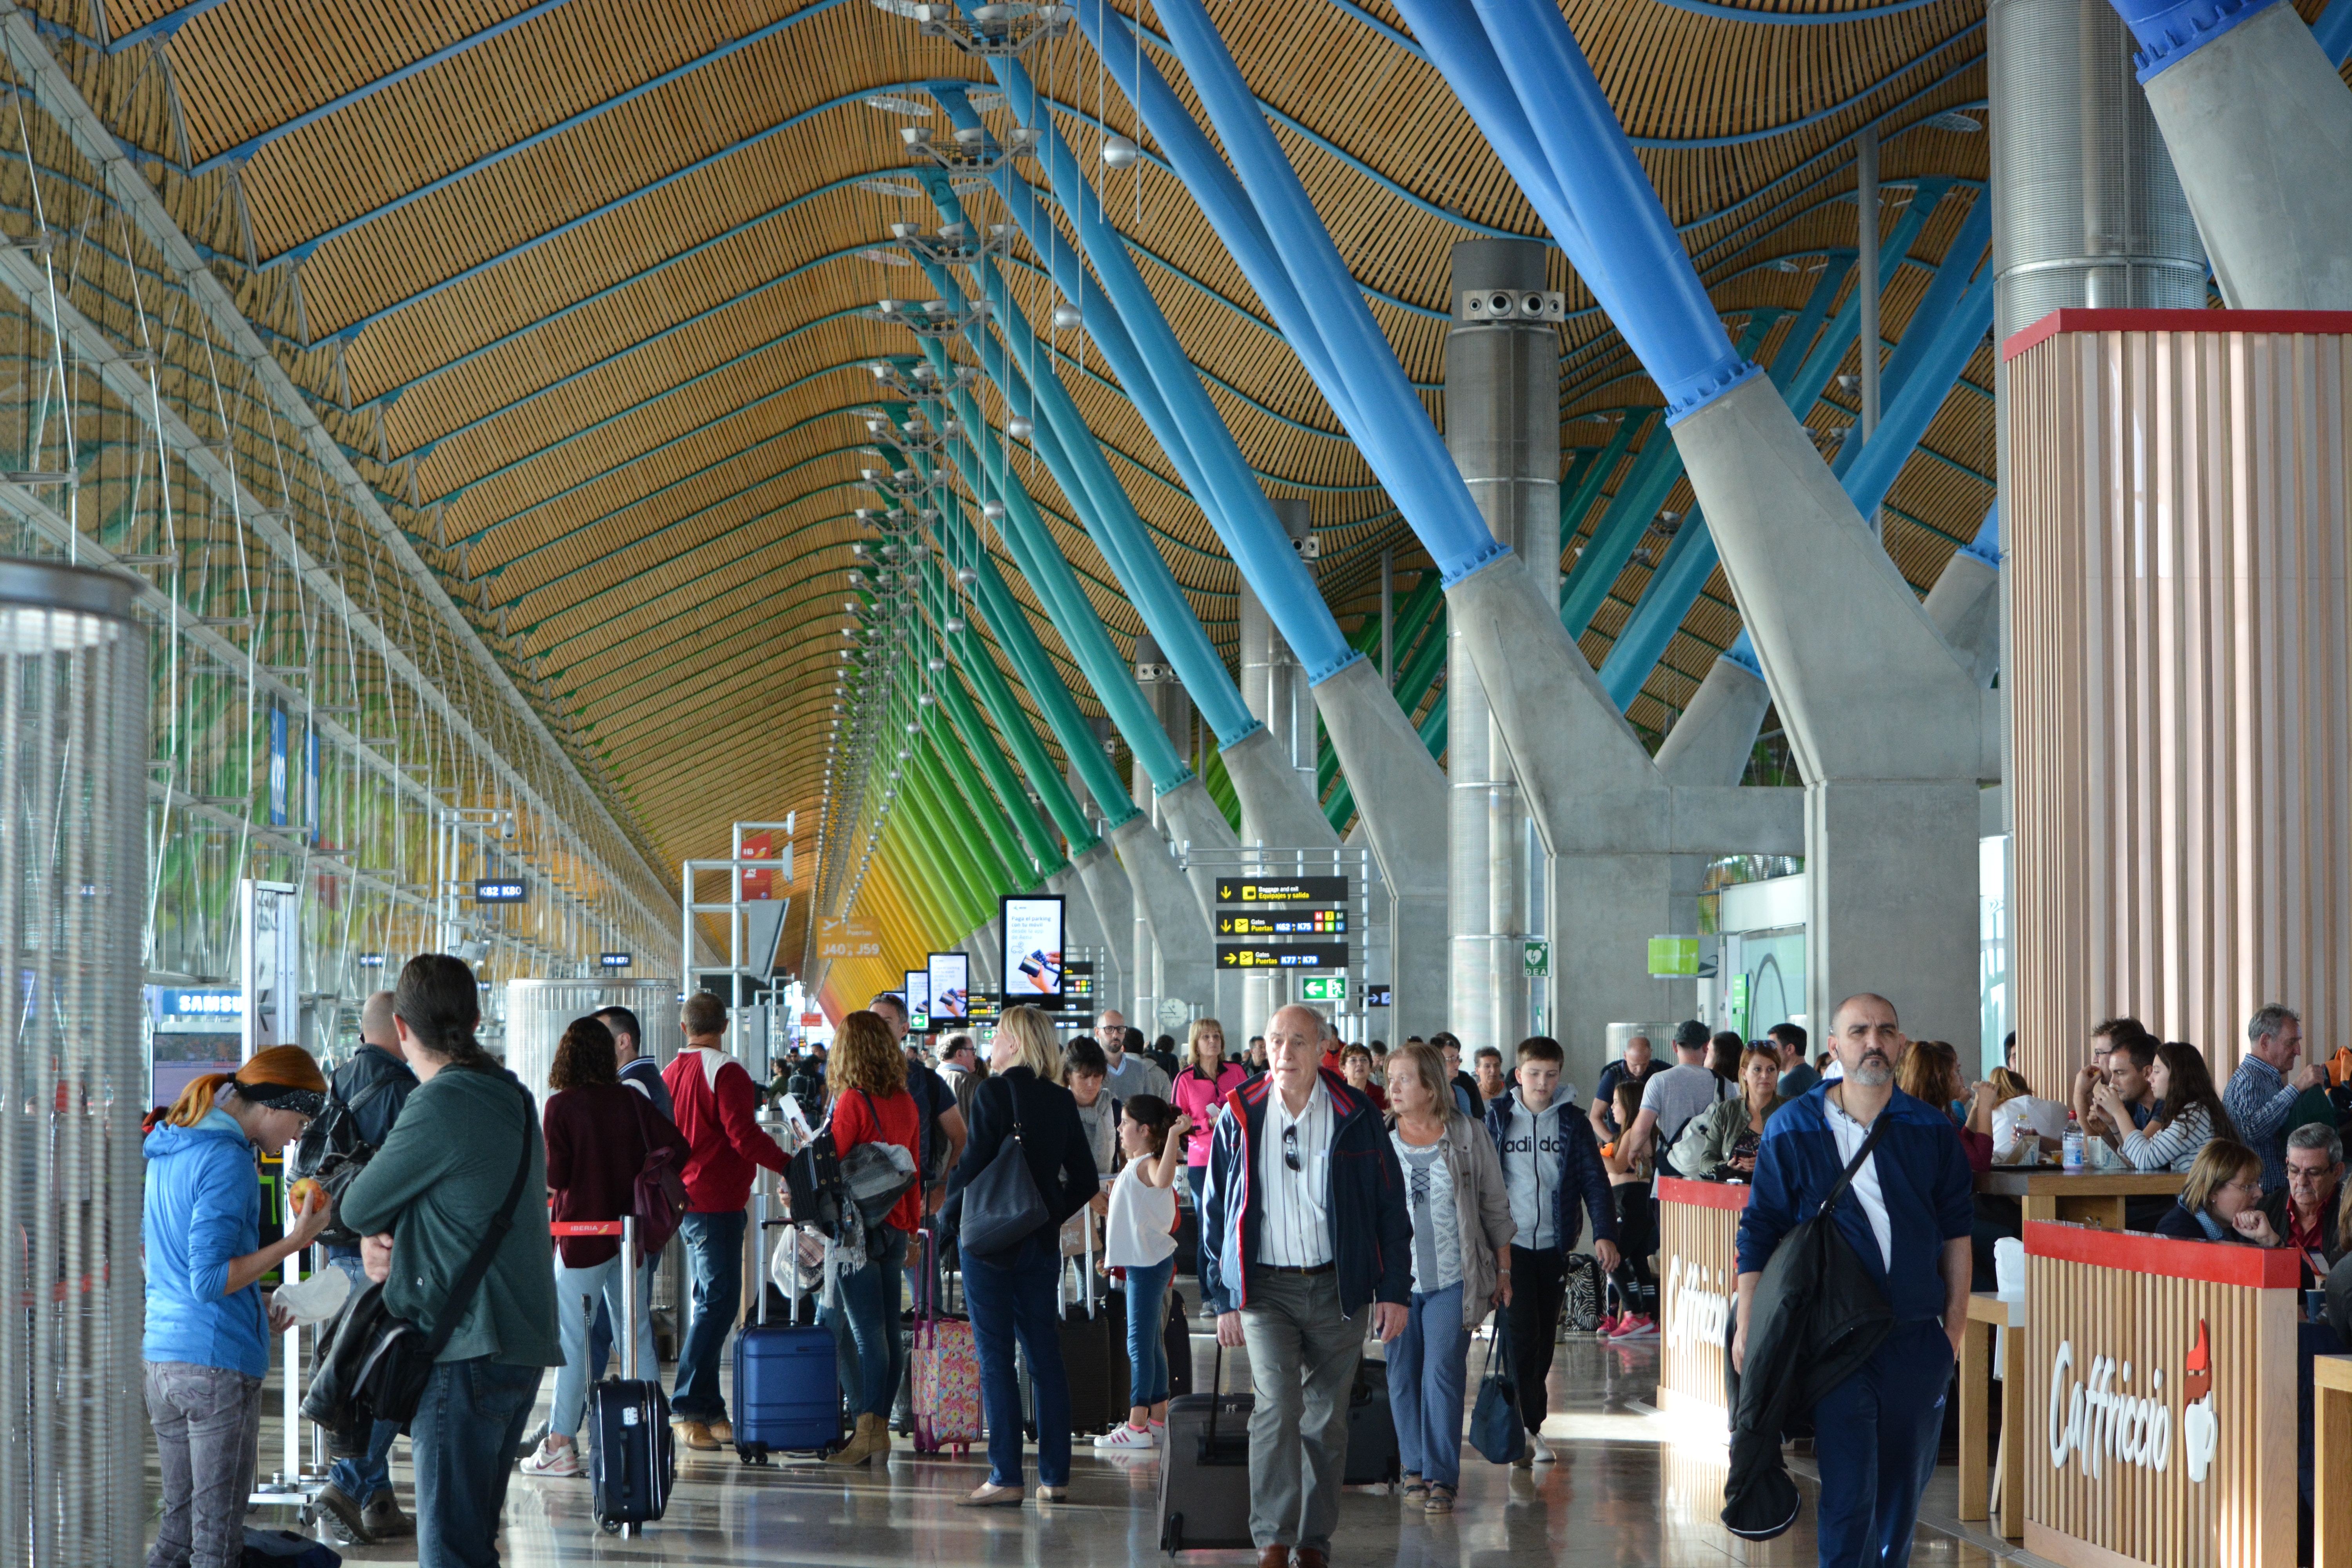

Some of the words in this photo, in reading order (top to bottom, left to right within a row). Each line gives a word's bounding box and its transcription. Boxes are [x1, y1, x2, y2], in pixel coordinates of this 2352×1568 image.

[480, 886, 499, 895] K82
[503, 886, 522, 895] K80
[822, 943, 846, 955] J40
[857, 943, 880, 955] J59
[1504, 1136, 1559, 1153] adida
[2049, 1340, 2172, 1479] Caffriccio
